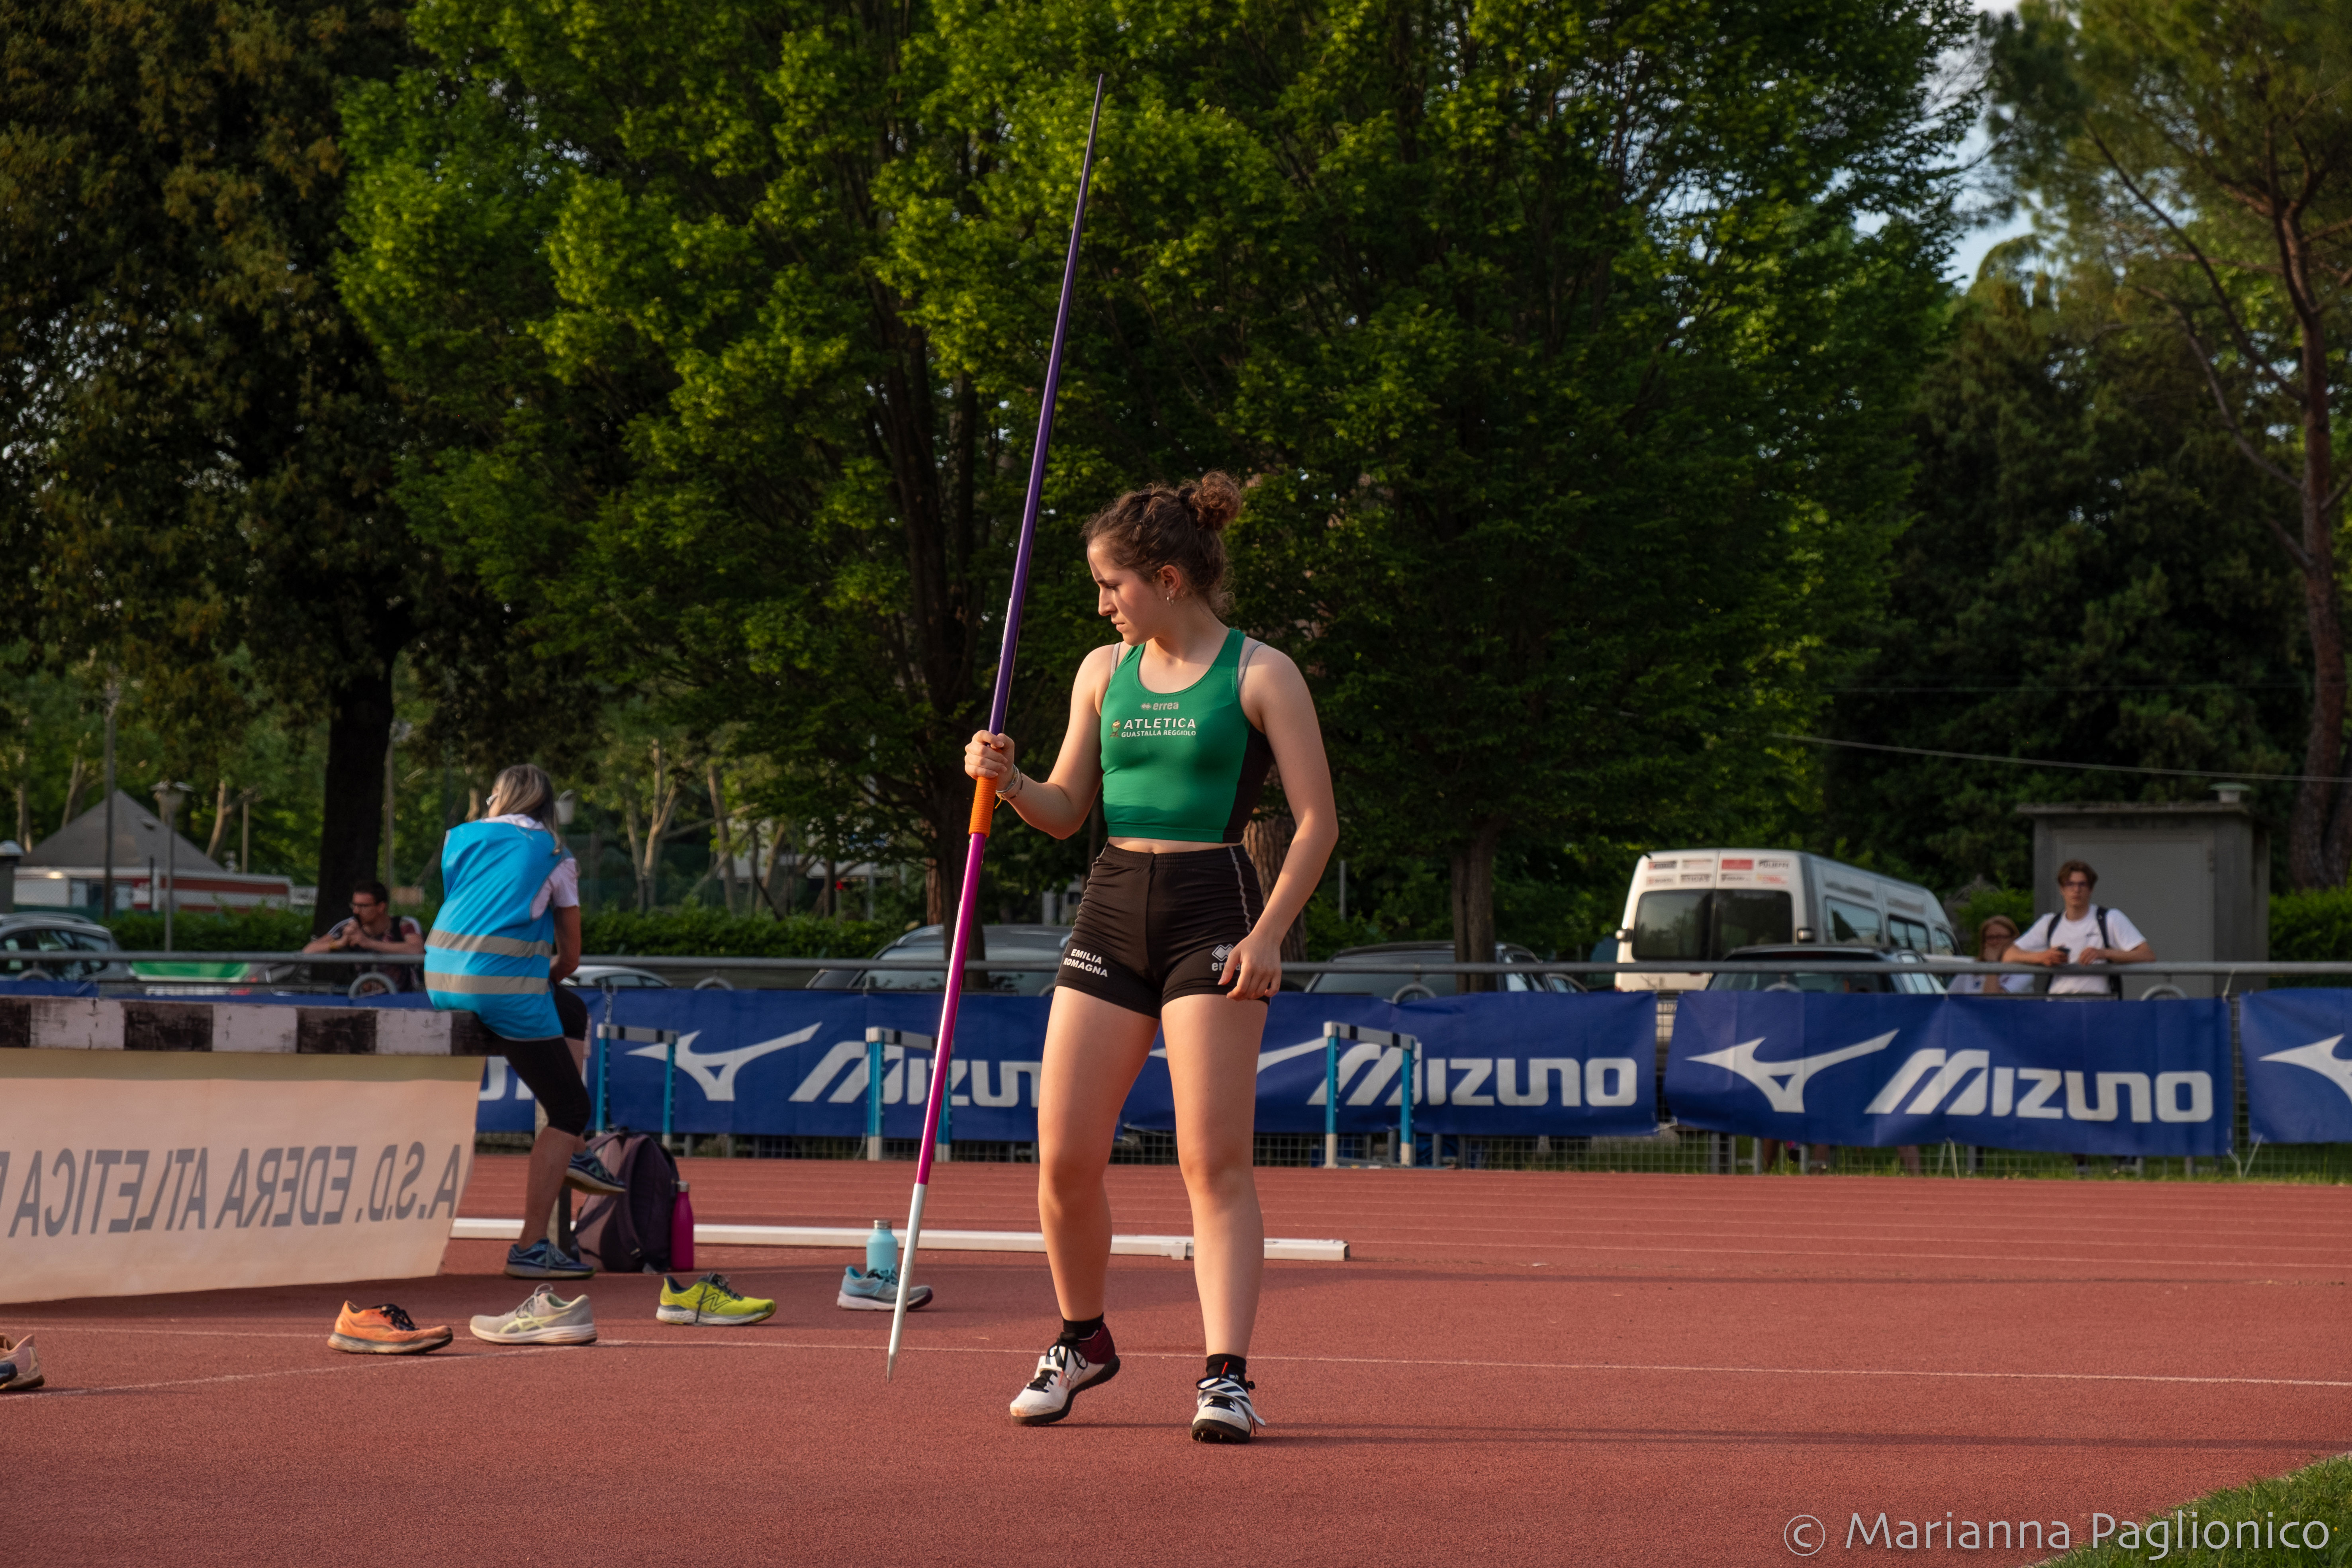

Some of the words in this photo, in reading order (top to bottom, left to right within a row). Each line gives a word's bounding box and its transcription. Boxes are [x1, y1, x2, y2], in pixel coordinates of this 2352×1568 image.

[1123, 718, 1196, 729] ATLETICA
[1071, 949, 1102, 964] EMILIA
[1063, 957, 1108, 977] ROMAGNA
[1212, 962, 1241, 971] era
[788, 1040, 1042, 1108] MIZUN
[1864, 1048, 2213, 1122] MIZUNO
